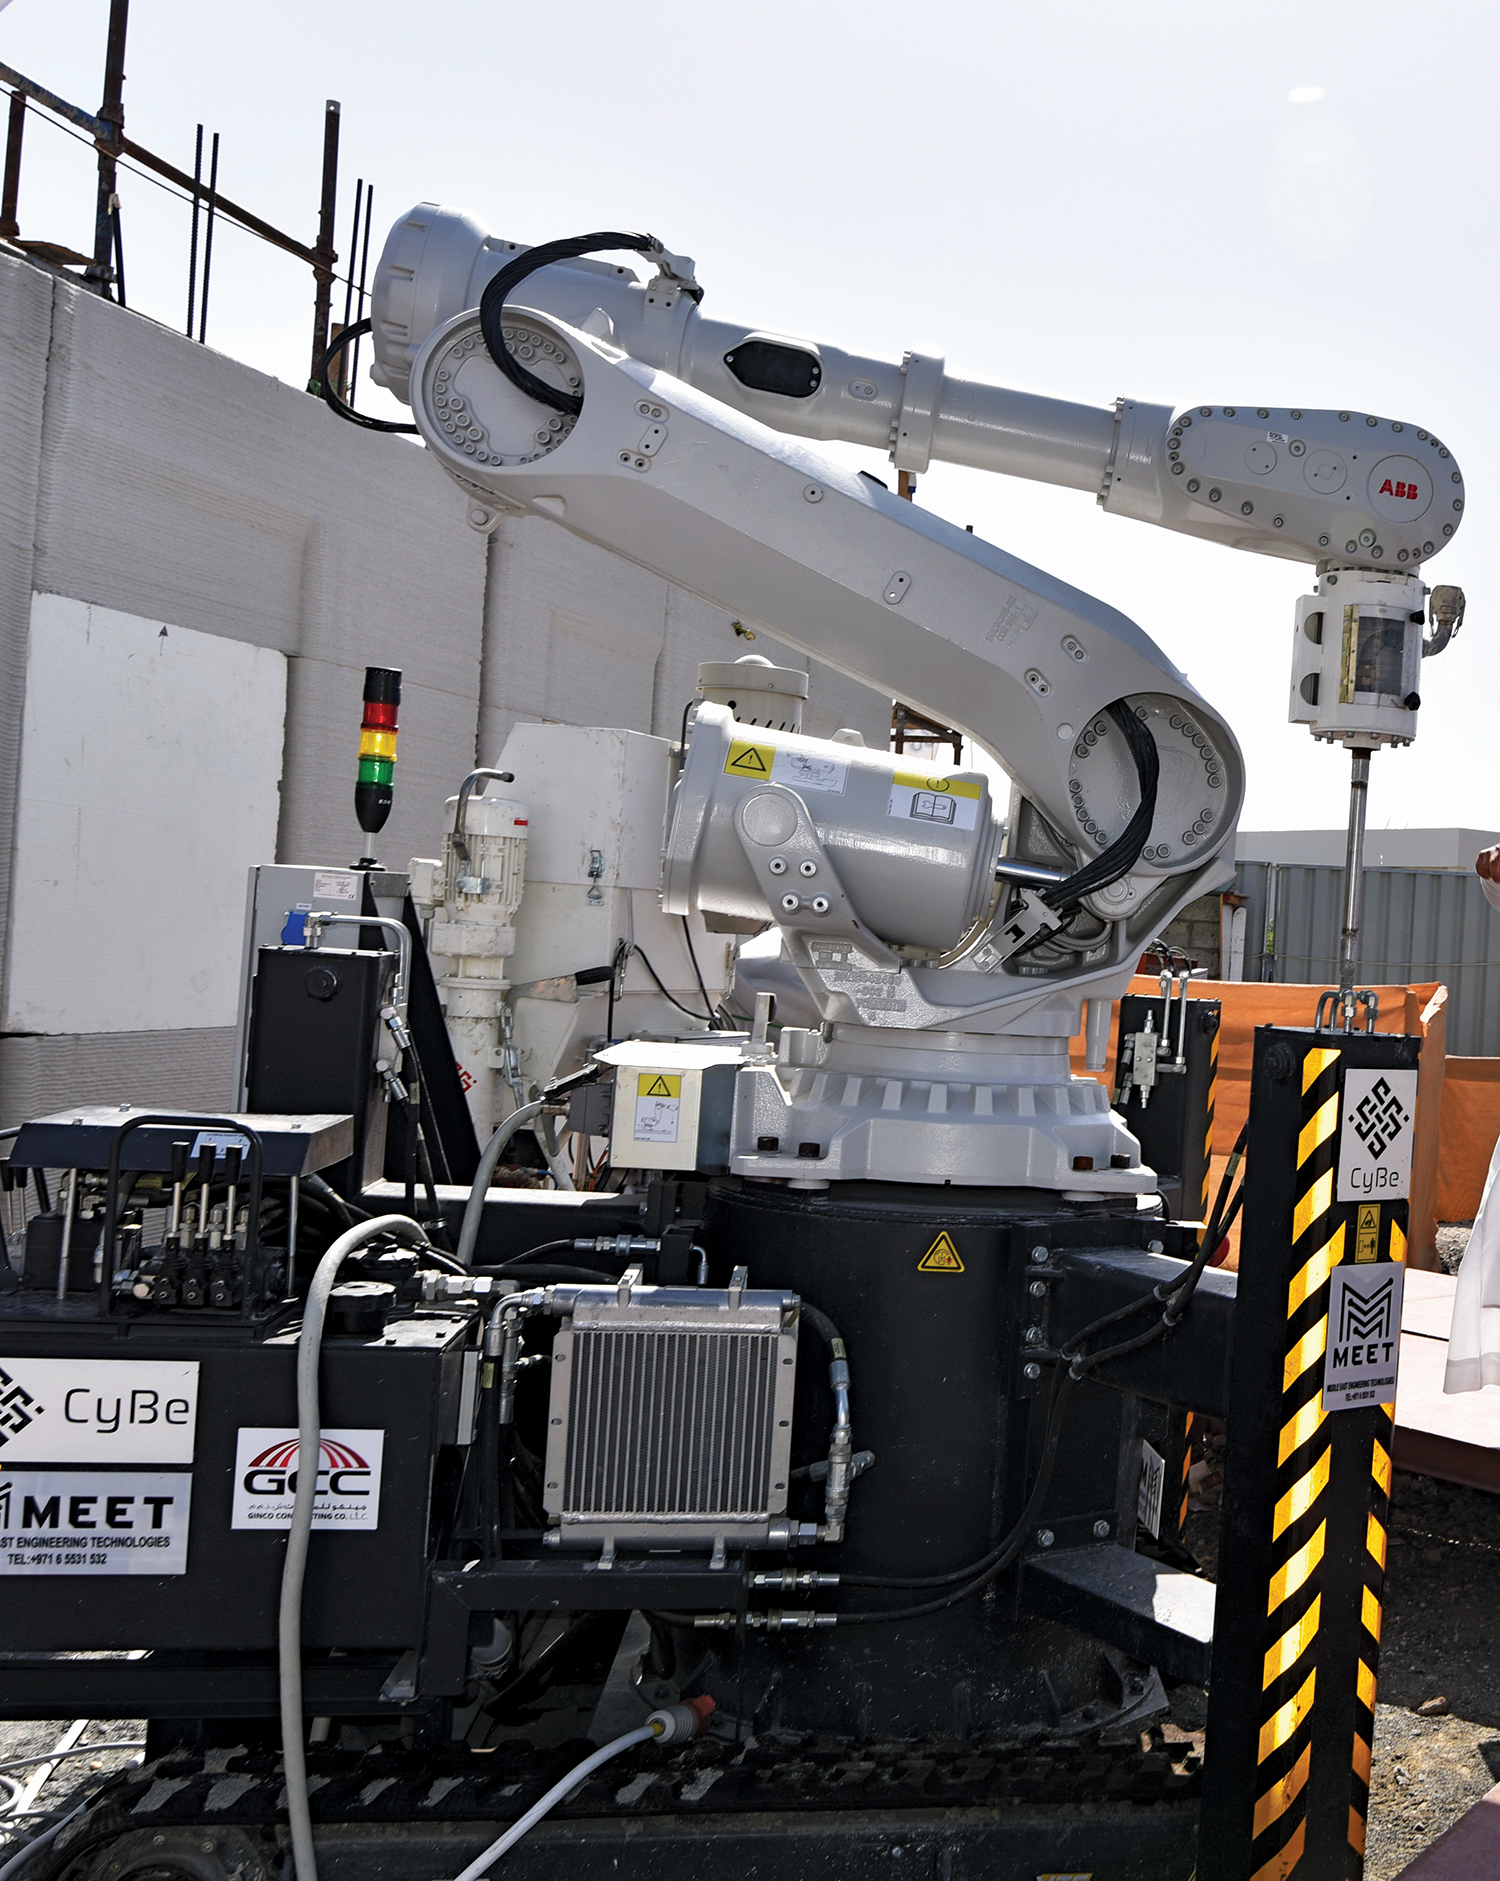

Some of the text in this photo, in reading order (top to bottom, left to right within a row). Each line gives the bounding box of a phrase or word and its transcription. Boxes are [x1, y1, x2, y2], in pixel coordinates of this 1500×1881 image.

[1378, 478, 1419, 501] ABB
[1350, 1167, 1400, 1194] CyBe
[1332, 1342, 1394, 1369] MEET
[64, 1388, 190, 1434] CyBe
[22, 1496, 174, 1529] MEET
[247, 1512, 274, 1520] GINCO
[276, 1512, 333, 1520] CONTING
[16, 1536, 88, 1548] ENGINEERING
[91, 1536, 171, 1548] TECHNOLOGIES
[64, 1553, 86, 1565] 5531
[89, 1553, 107, 1564] 532
